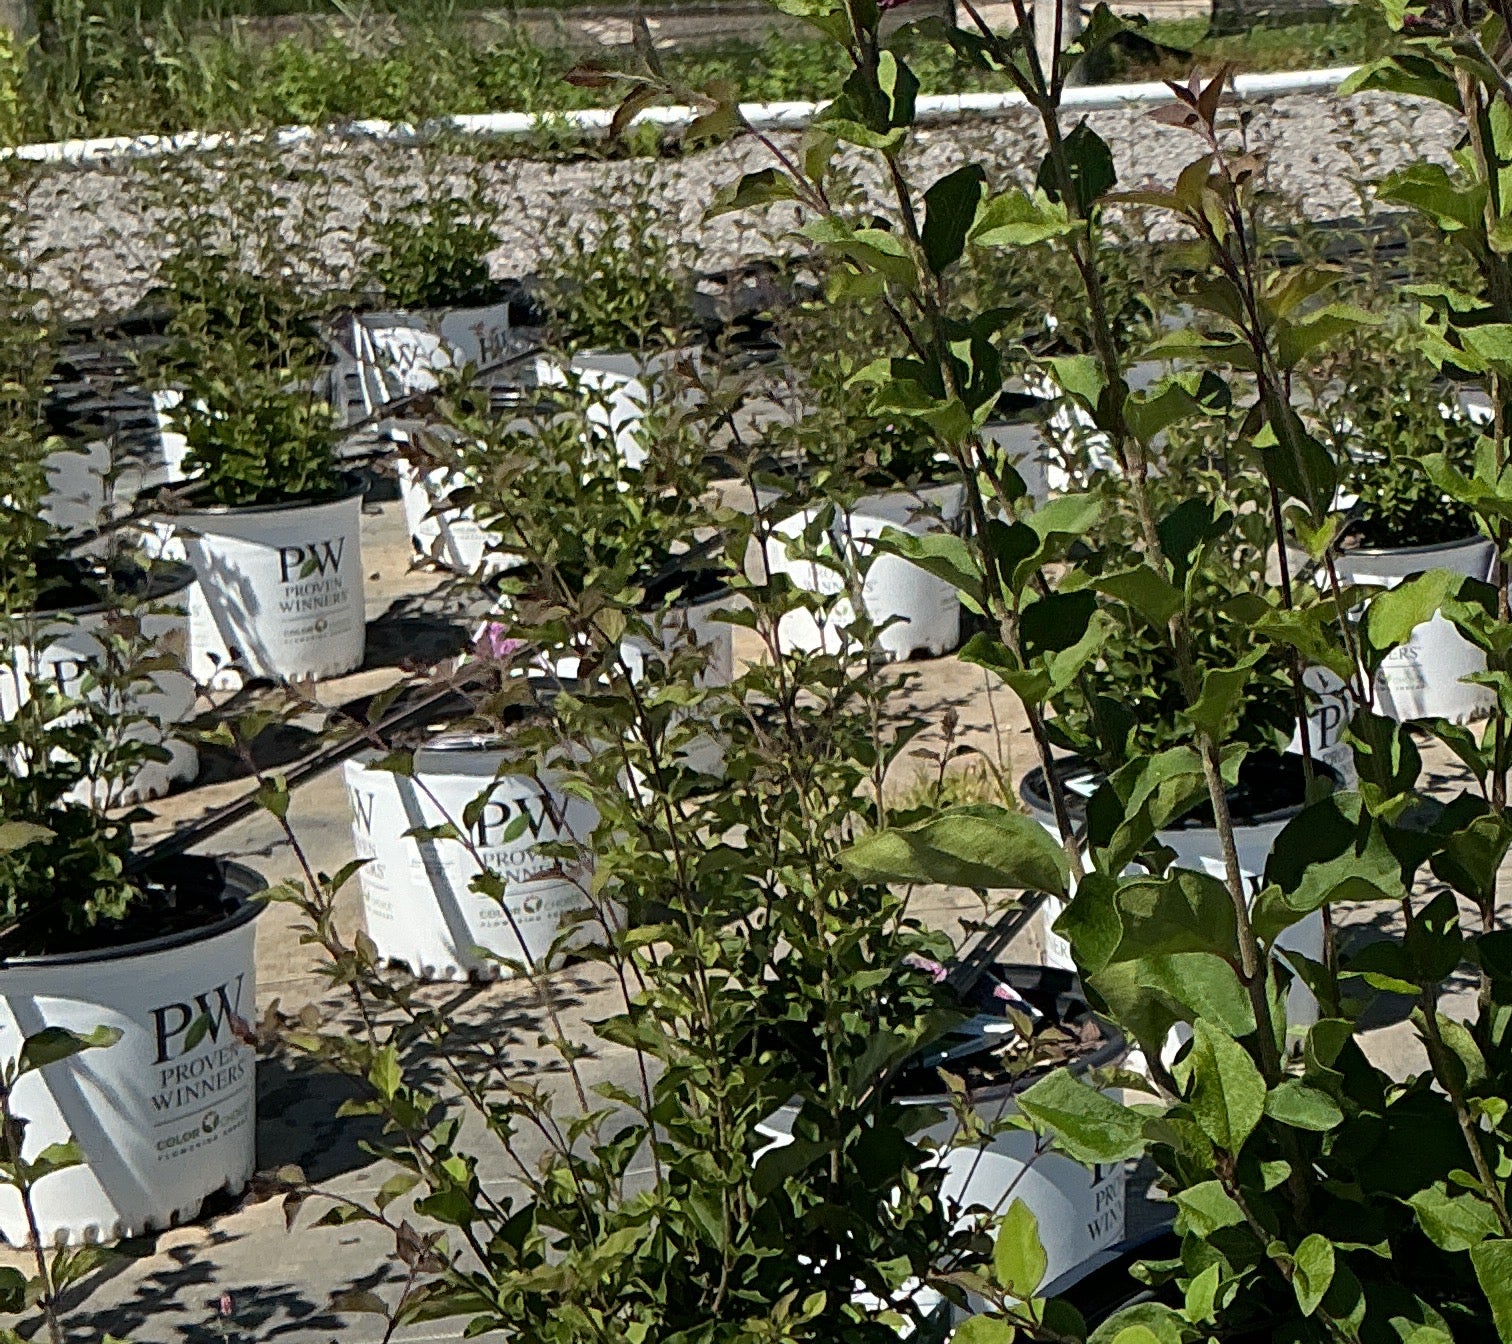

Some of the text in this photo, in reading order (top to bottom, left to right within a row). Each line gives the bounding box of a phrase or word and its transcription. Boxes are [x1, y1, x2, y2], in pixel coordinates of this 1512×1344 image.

[278, 537, 345, 583] PW
[148, 972, 244, 1066] PW
[151, 1061, 245, 1112] WINNERS
[160, 1043, 239, 1088] PROVEN
